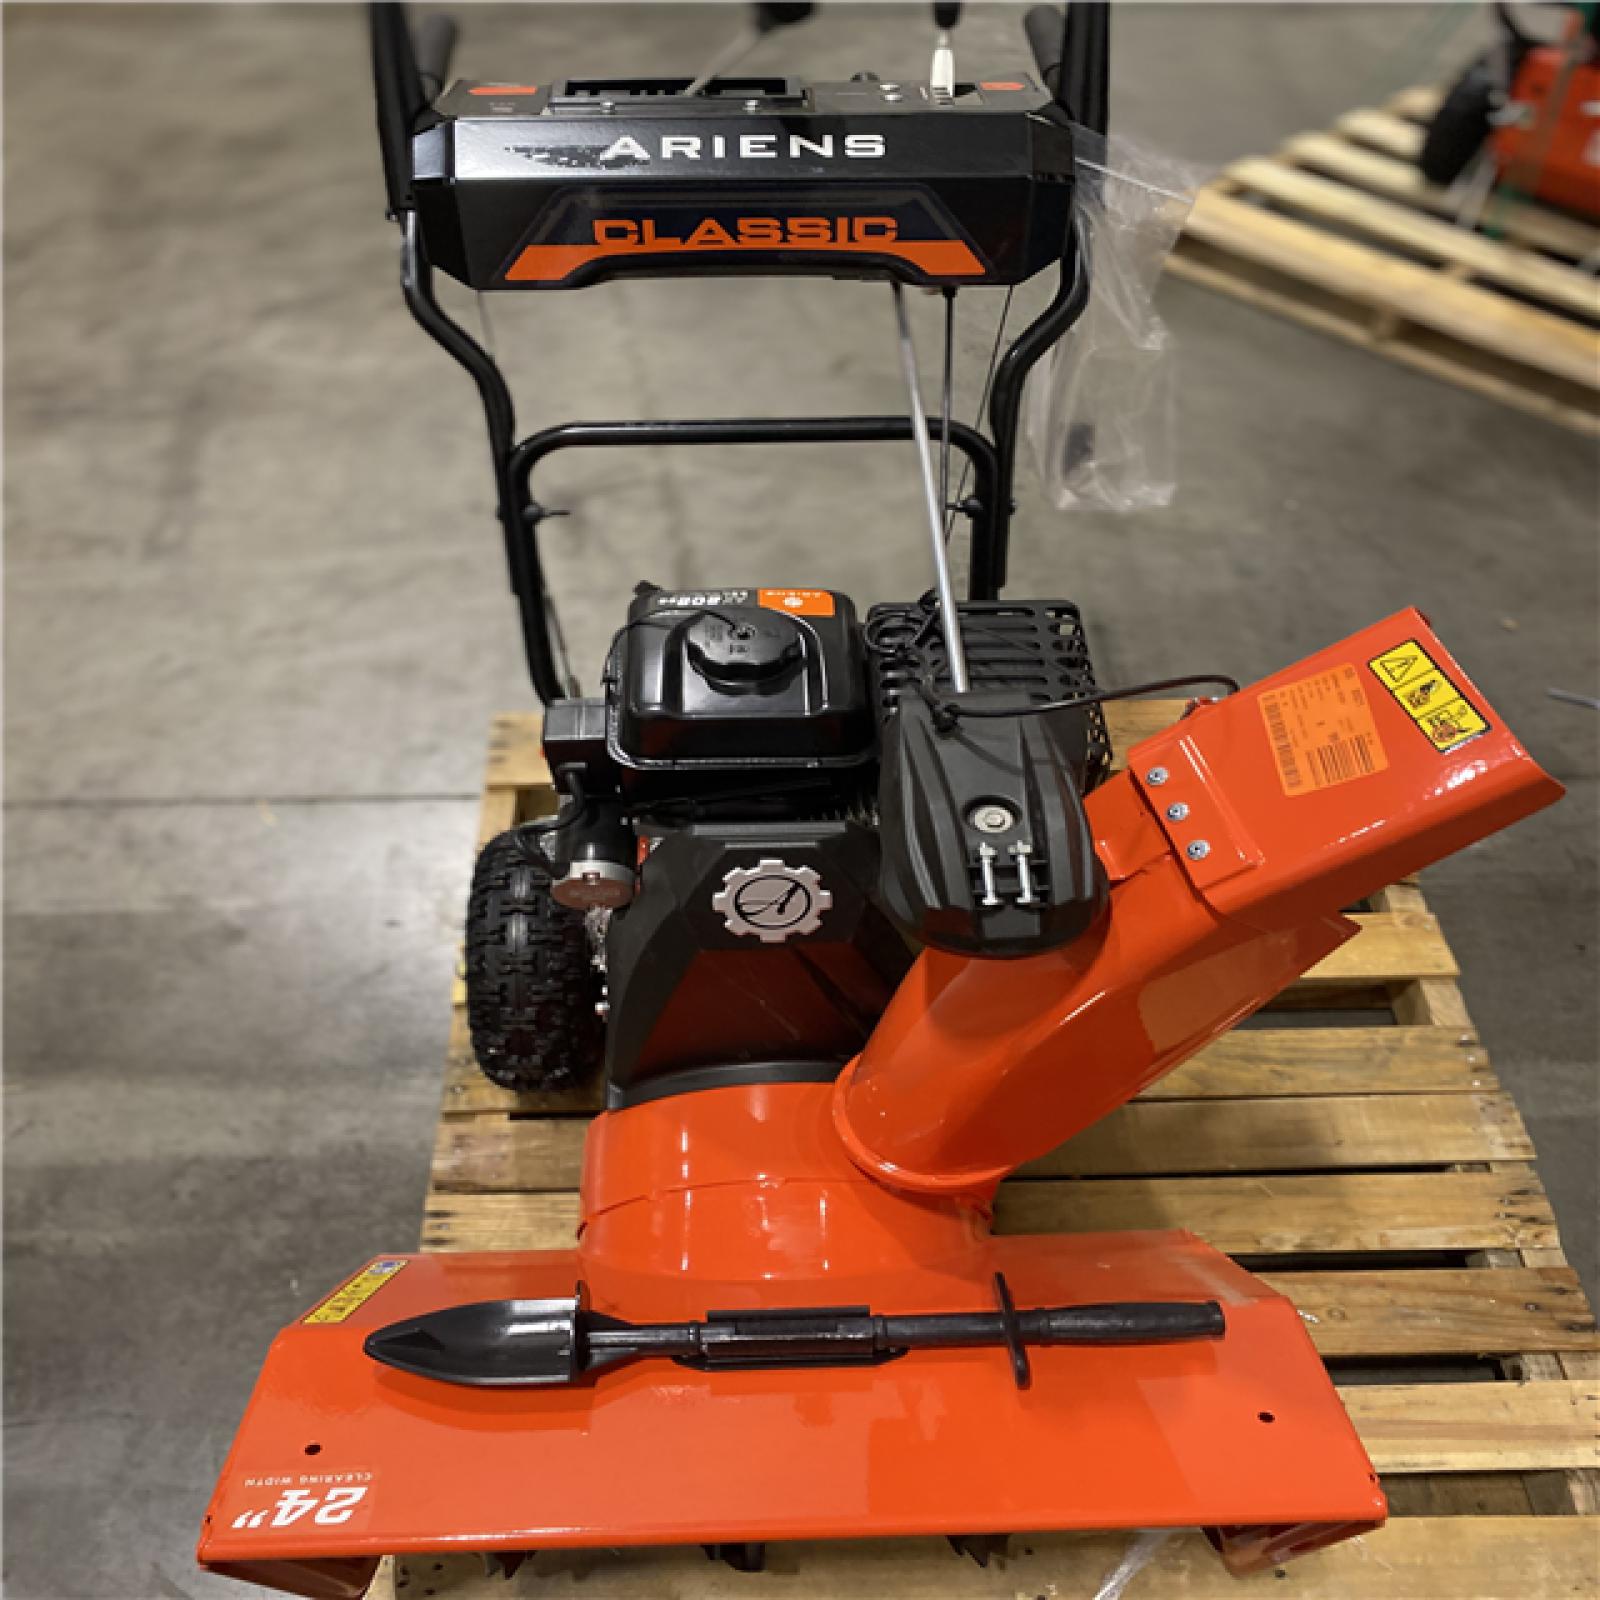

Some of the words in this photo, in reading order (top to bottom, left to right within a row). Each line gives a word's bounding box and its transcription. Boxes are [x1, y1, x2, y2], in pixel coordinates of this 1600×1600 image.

[599, 134, 886, 161] ARIENS
[592, 216, 898, 247] CLASSIC
[244, 1476, 293, 1487] WIDTH
[299, 1471, 372, 1485] CLEARING
